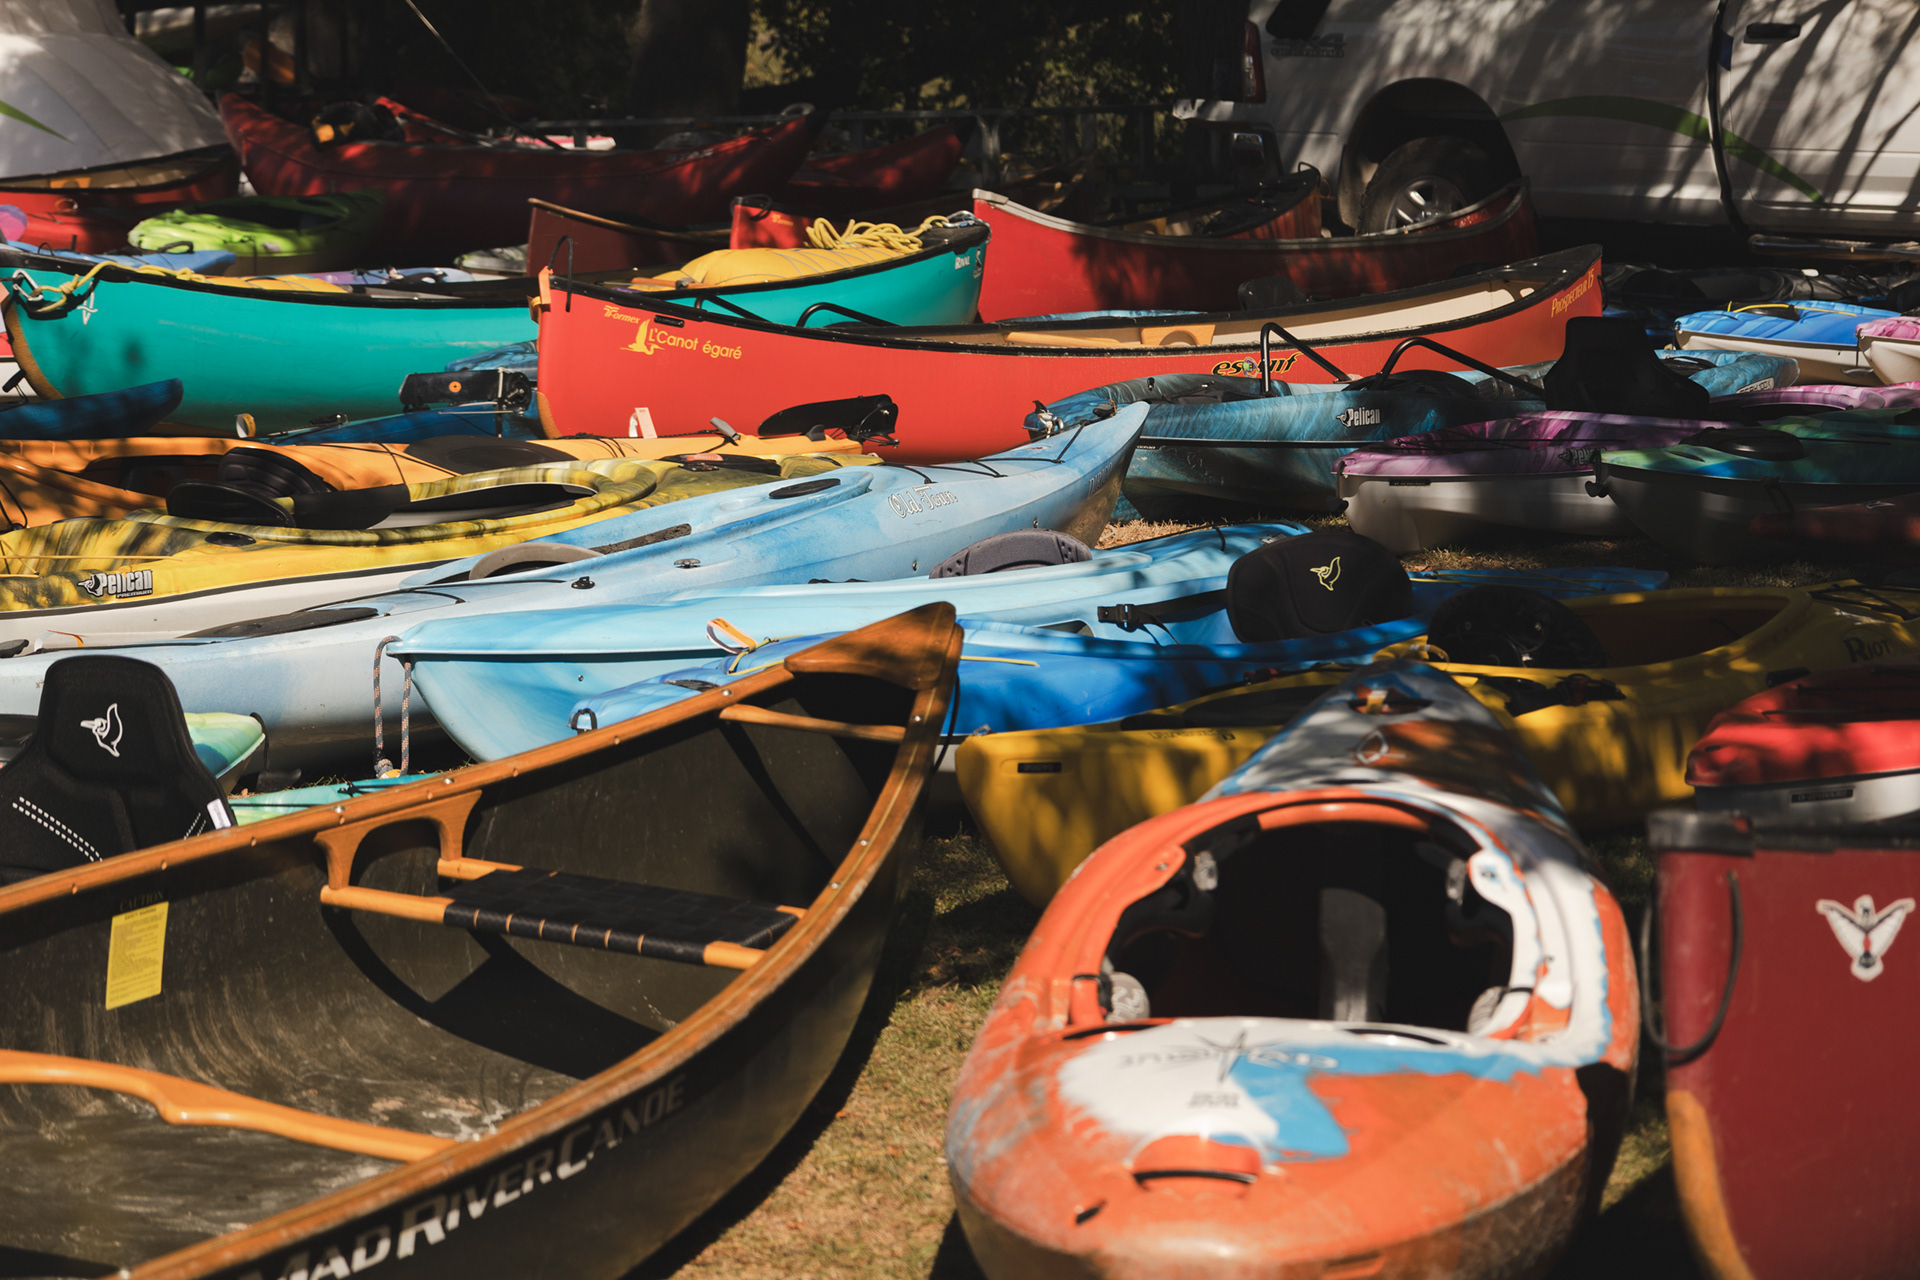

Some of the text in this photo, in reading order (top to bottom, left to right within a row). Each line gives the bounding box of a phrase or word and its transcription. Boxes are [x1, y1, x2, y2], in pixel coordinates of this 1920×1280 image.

[702, 340, 742, 360] égaré
[1343, 407, 1381, 427] Pelican
[887, 490, 923, 518] Old
[92, 569, 153, 597] Pelican
